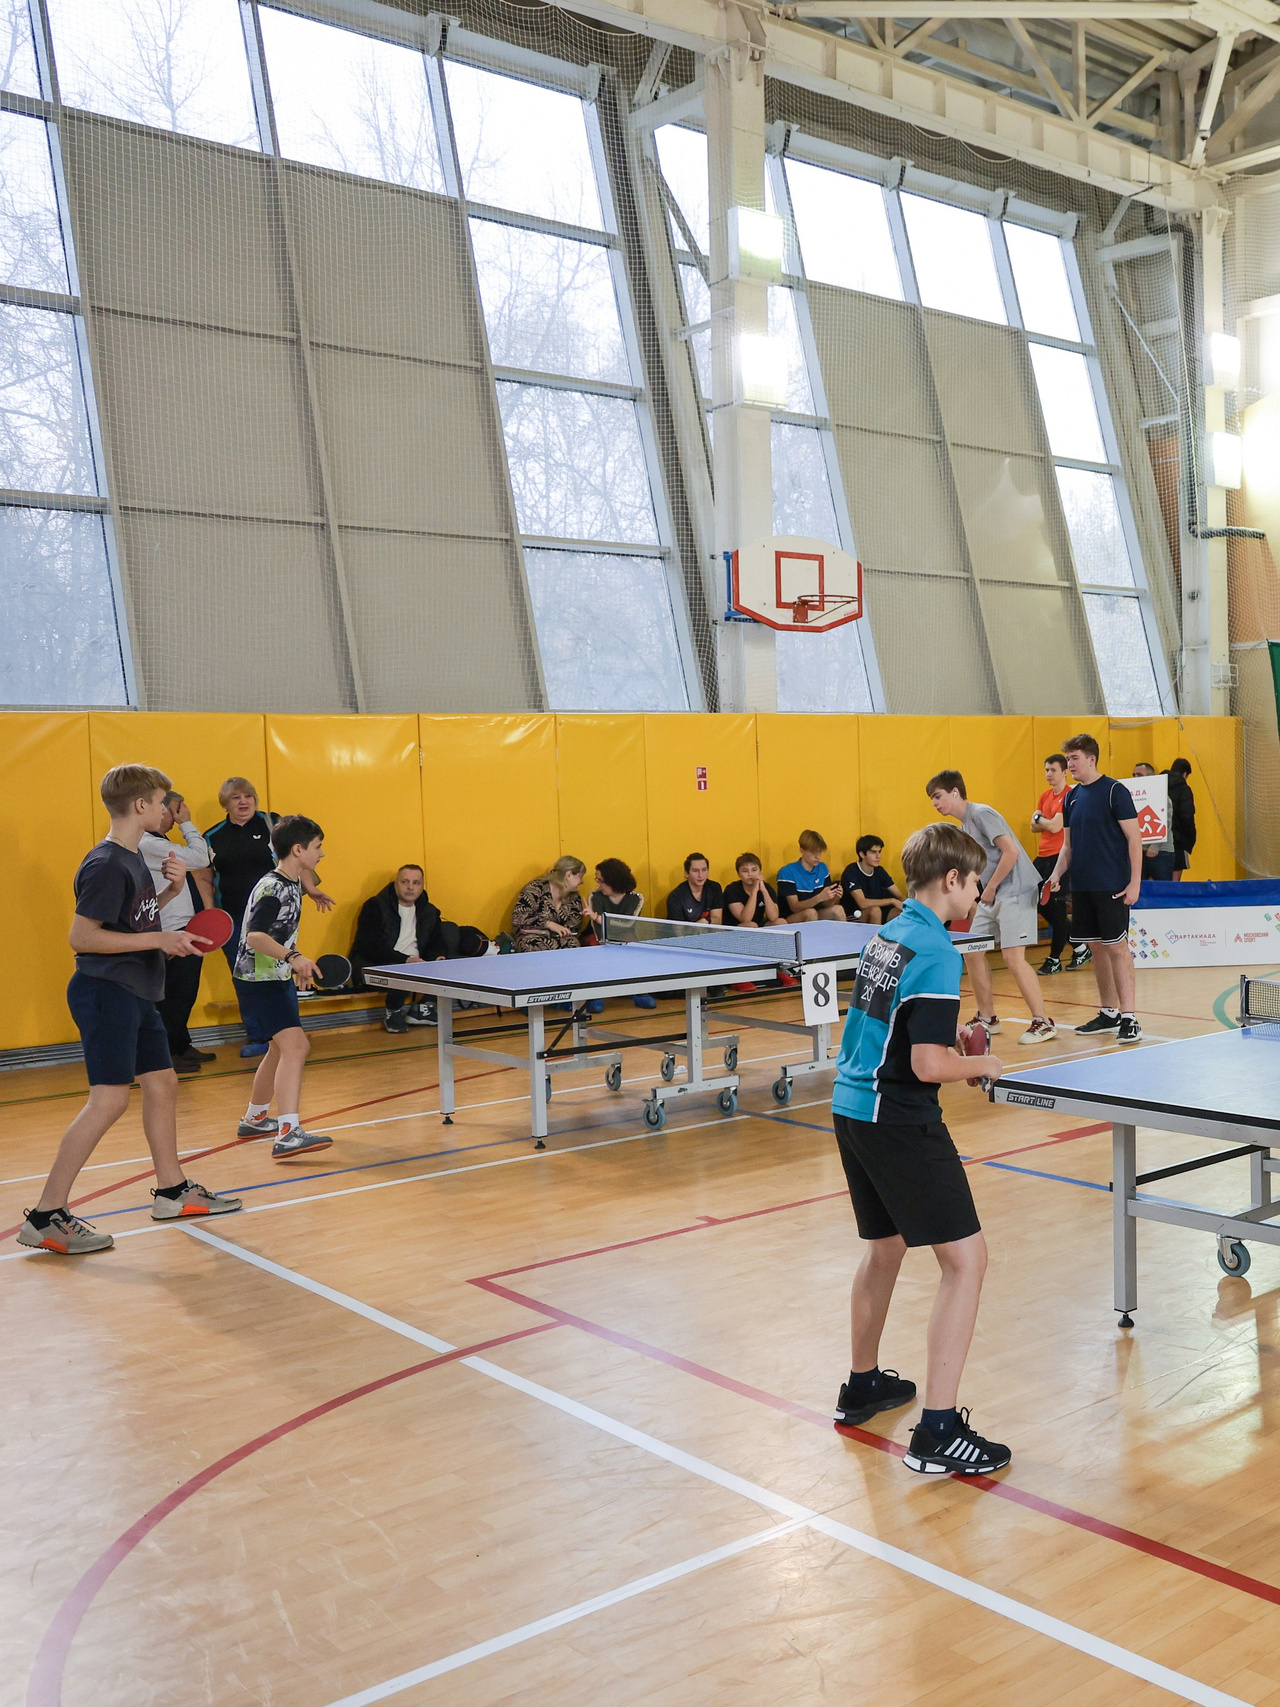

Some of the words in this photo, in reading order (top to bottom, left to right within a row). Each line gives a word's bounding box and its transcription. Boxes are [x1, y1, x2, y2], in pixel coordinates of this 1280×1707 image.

[812, 971, 831, 1008] 8
[528, 994, 554, 1003] START
[555, 992, 570, 1000] LINE
[1008, 1093, 1035, 1105] START
[1036, 1096, 1054, 1107] LINE
